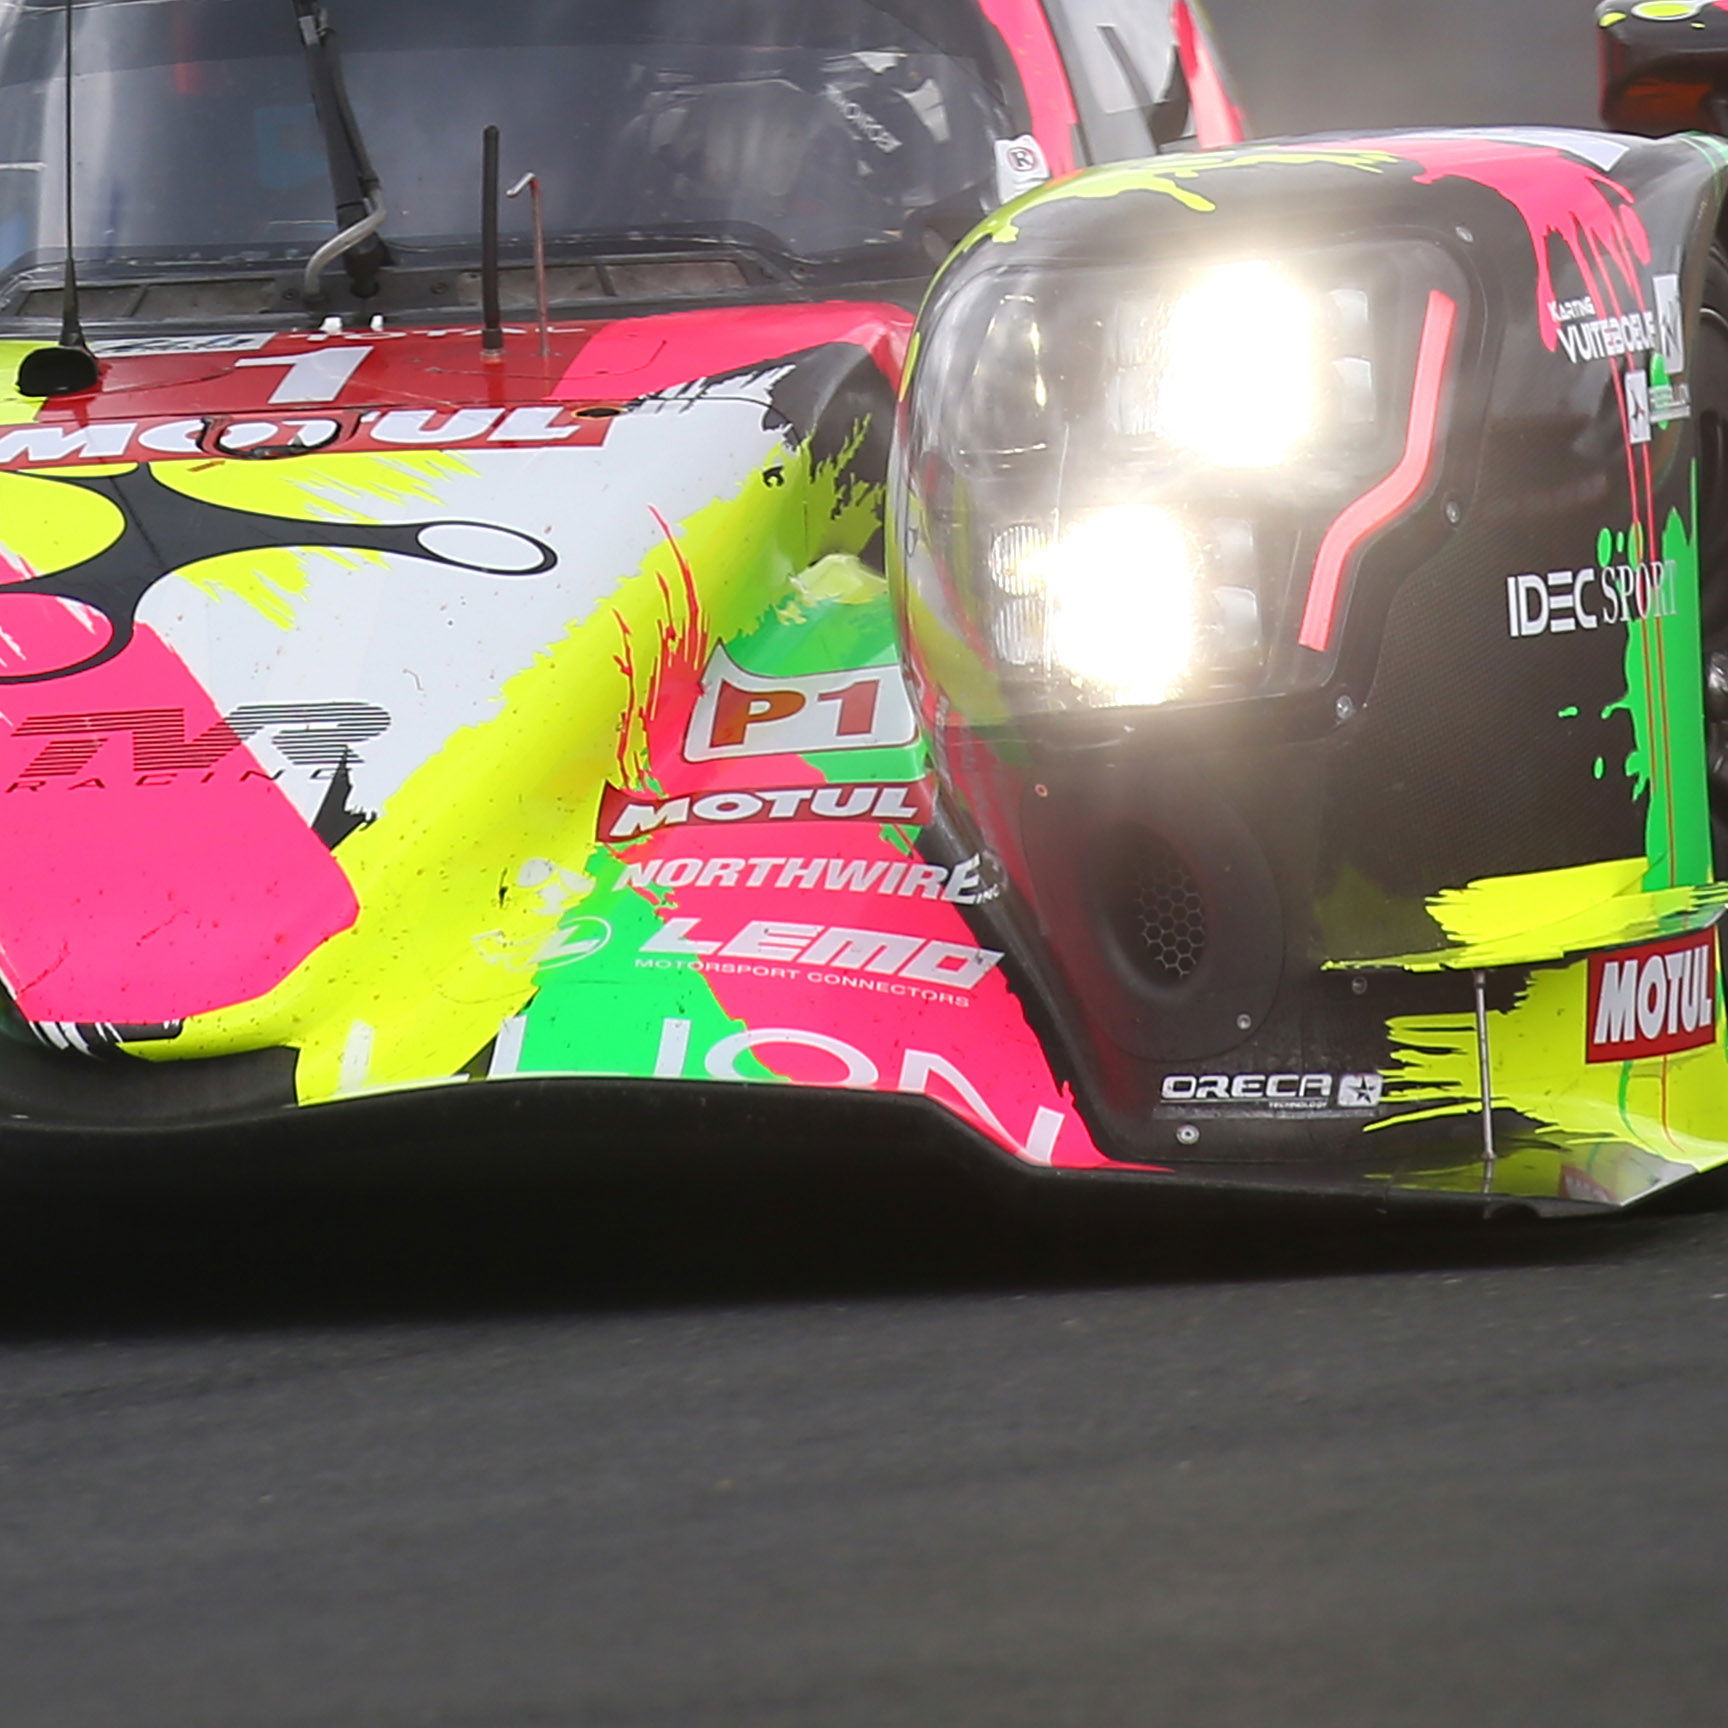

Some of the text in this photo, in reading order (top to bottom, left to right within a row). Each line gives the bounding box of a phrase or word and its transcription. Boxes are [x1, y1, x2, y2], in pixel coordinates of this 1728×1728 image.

[236, 346, 373, 404] 1
[1507, 560, 1677, 637] IDEC SPORT
[709, 677, 880, 749] P1
[607, 786, 918, 837] MOTUL
[612, 852, 981, 905] NORTHWIRE
[638, 917, 1005, 990] LEMO
[634, 957, 970, 1009] MOTORSPORT CONNECTORS
[1594, 944, 1714, 1046] MOTUL
[1161, 1074, 1333, 1099] ORECA
